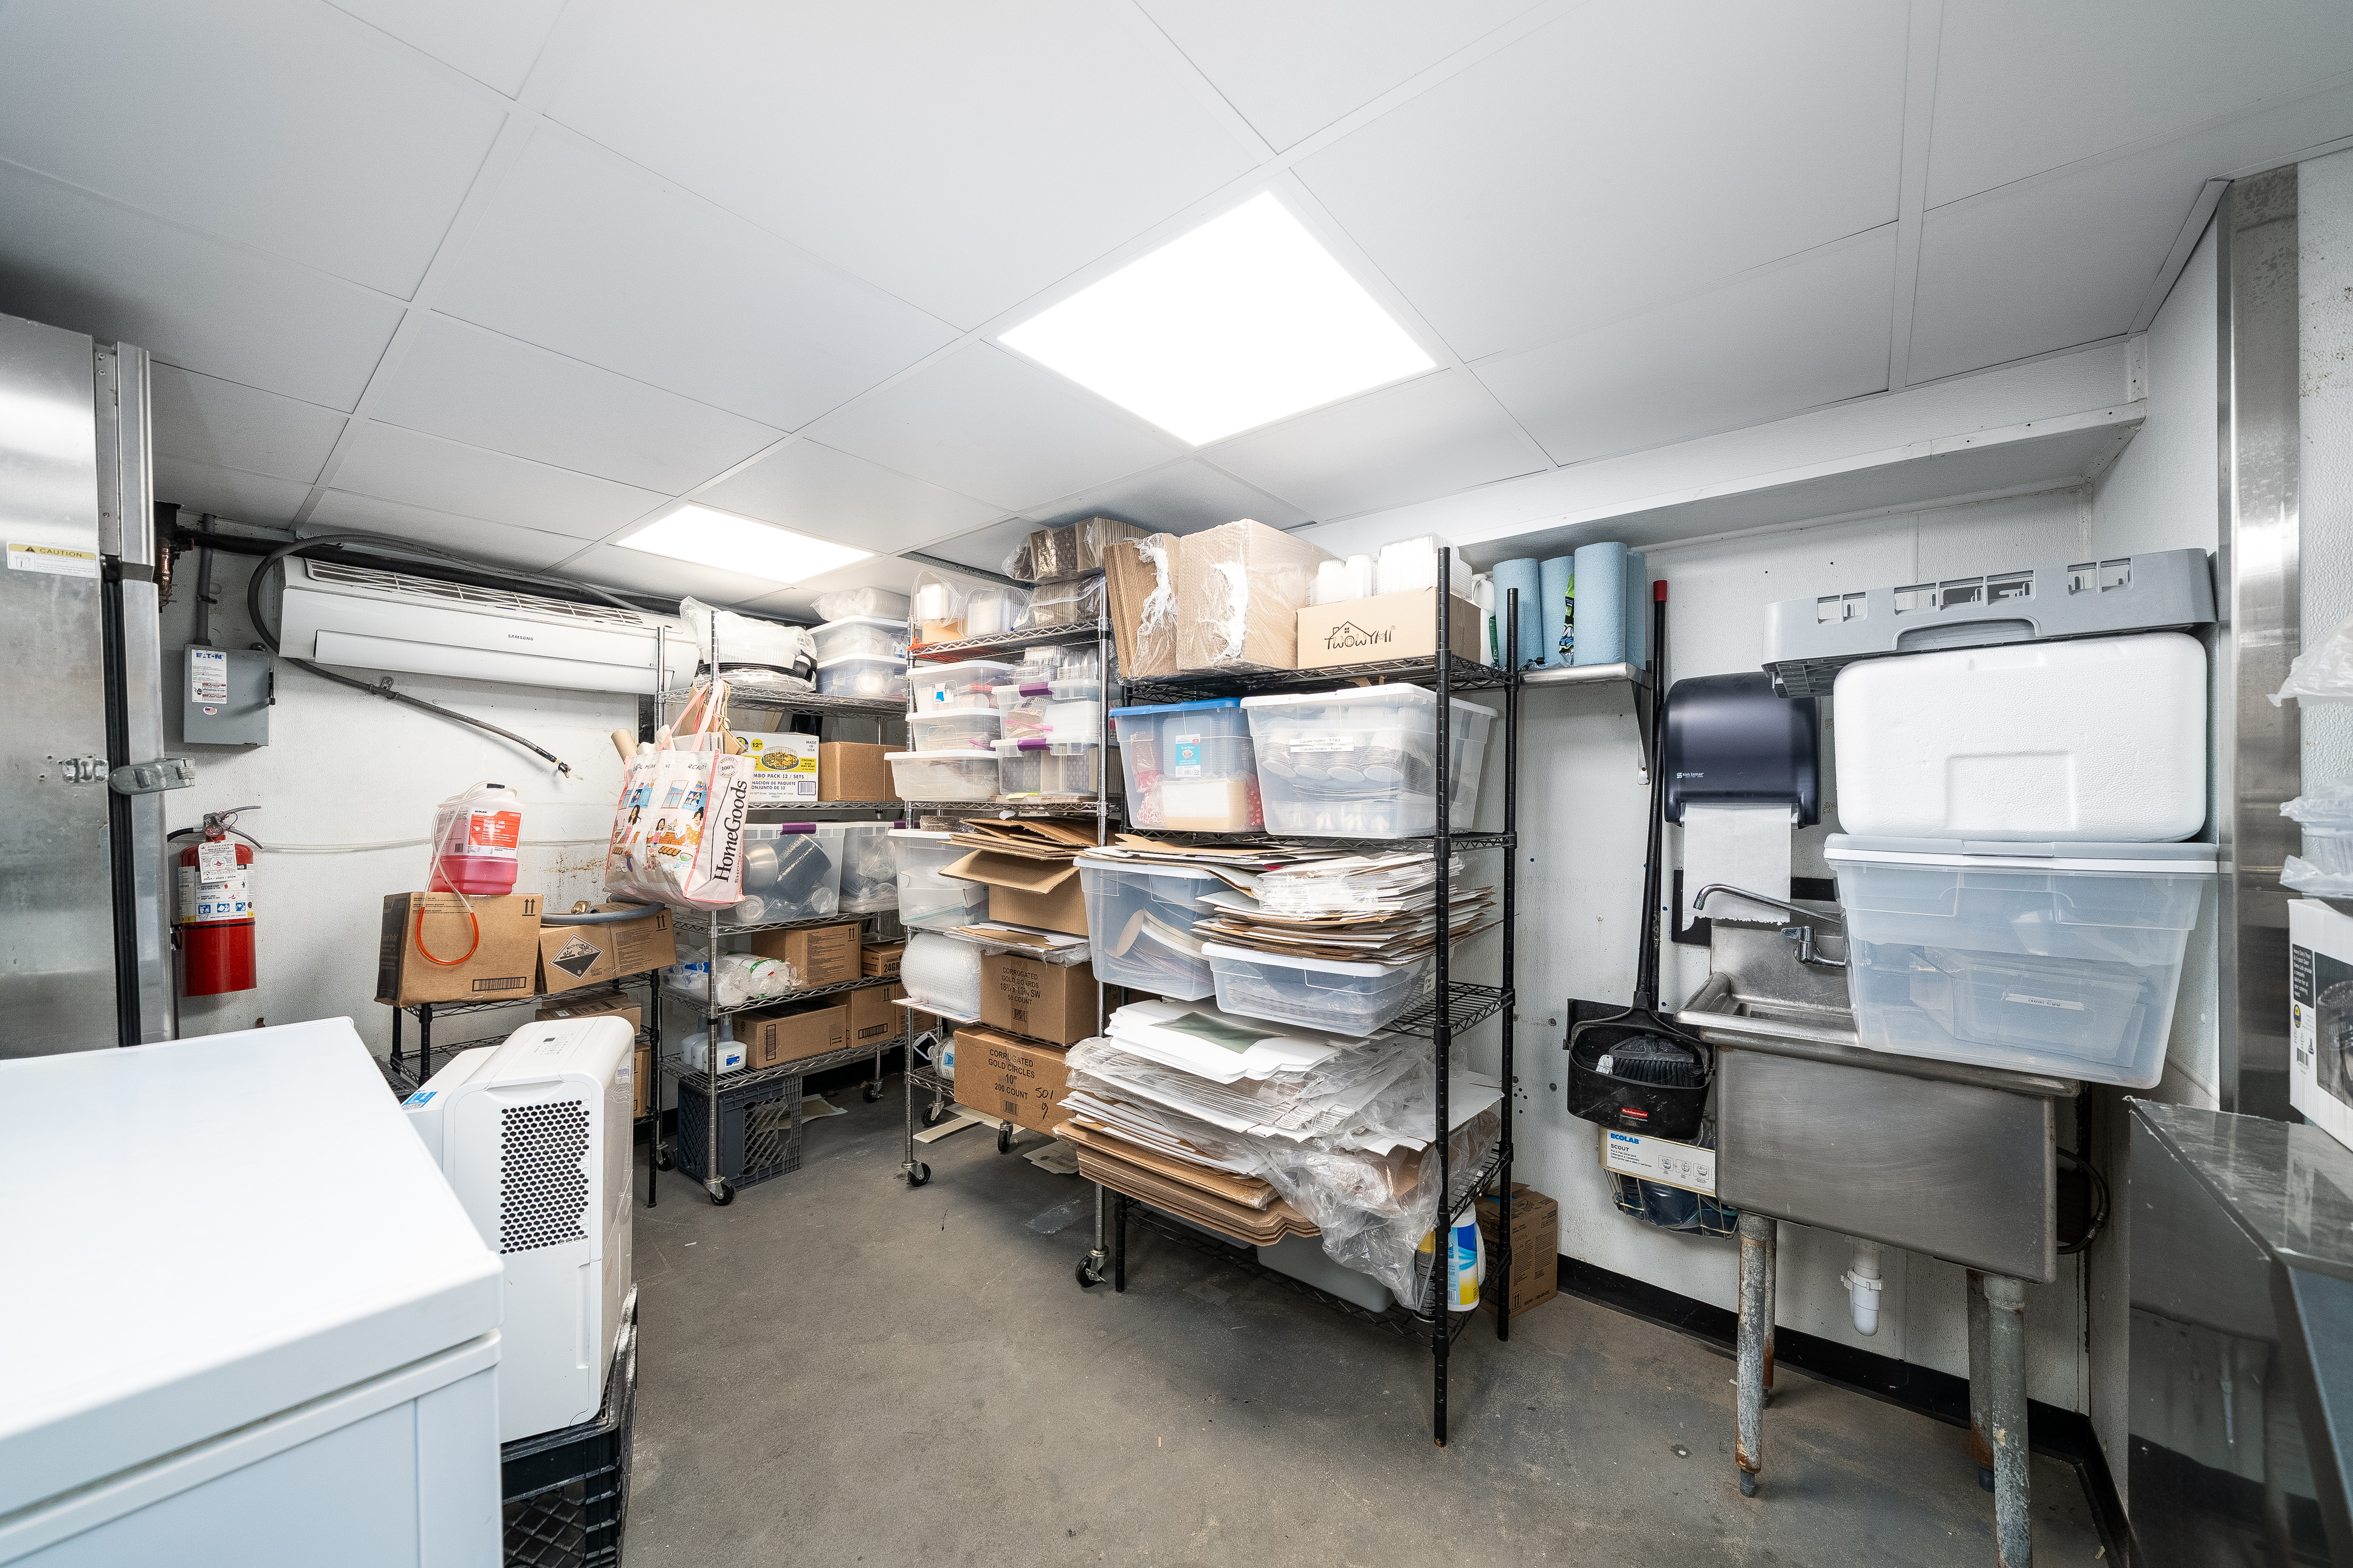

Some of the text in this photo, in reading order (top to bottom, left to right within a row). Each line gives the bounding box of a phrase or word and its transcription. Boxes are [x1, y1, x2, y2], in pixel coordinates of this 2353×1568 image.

[40, 548, 82, 558] CAUTION
[712, 780, 747, 883] HomeGoods
[1002, 967, 1038, 980] CORRUGATED
[1001, 975, 1039, 989] GOLD BOARDS
[1014, 996, 1032, 1005] COUNT
[1031, 989, 1041, 999] SW
[989, 1049, 1033, 1067] CORRUGATED
[988, 1058, 1035, 1078] GOLD CIRCLES
[1006, 1073, 1017, 1084] 10"
[994, 1083, 1028, 1100] 200 COUNT
[1610, 1132, 1640, 1145] ECOLAB
[1610, 1143, 1629, 1152] SCOUT
